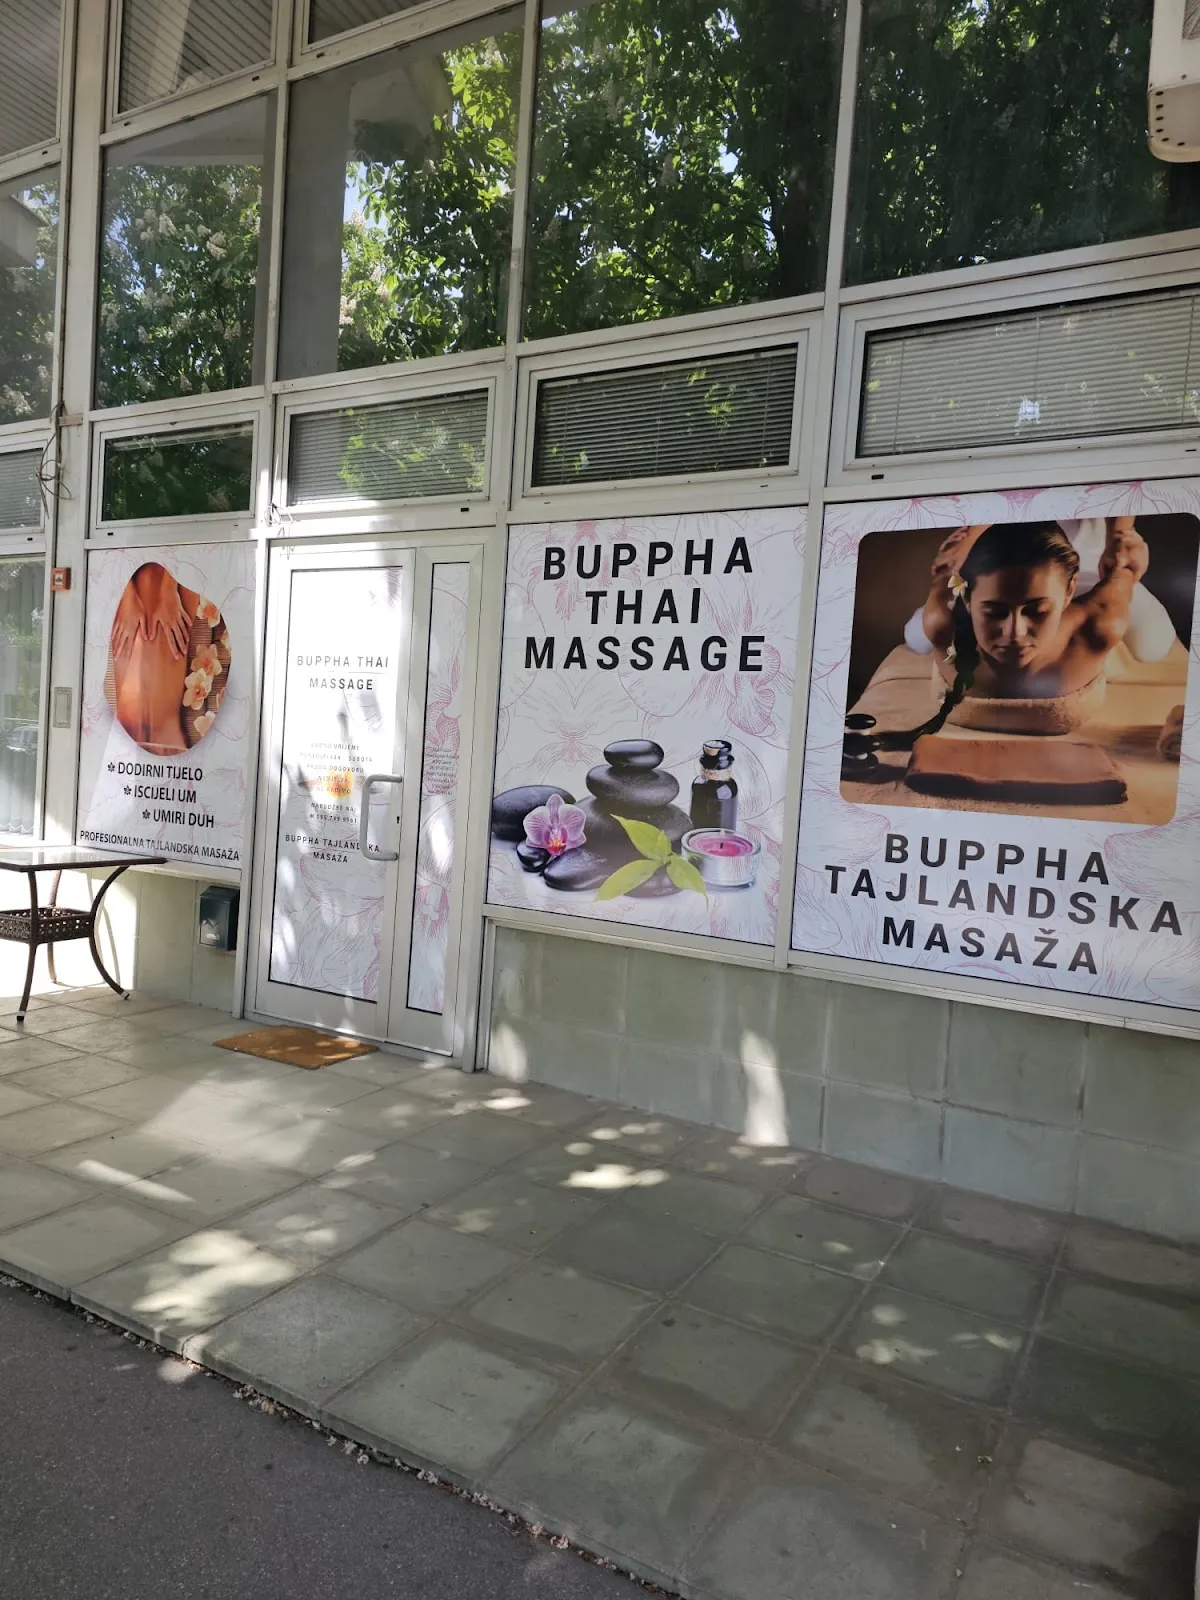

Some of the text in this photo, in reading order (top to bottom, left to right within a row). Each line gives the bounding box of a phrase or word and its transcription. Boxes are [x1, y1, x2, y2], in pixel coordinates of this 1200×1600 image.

[544, 537, 752, 580] BUPPHA
[586, 588, 701, 625] THAI
[297, 655, 389, 668] BUPPHA THAI
[525, 636, 766, 672] MASSAGE
[309, 677, 373, 690] MASSAGE
[117, 761, 203, 781] DODIRNI TIJELO
[134, 785, 197, 803] ISCIJELI UM
[153, 809, 214, 828] UMIRI DUH
[80, 830, 240, 861] PROFESIONALNA TAJLANDSKA MASAŽA
[285, 834, 319, 845] BUPPHA
[885, 834, 1110, 886] BUPPHA
[825, 865, 1183, 936] TAJLANDSKA
[883, 914, 1098, 975] MASAŽA
